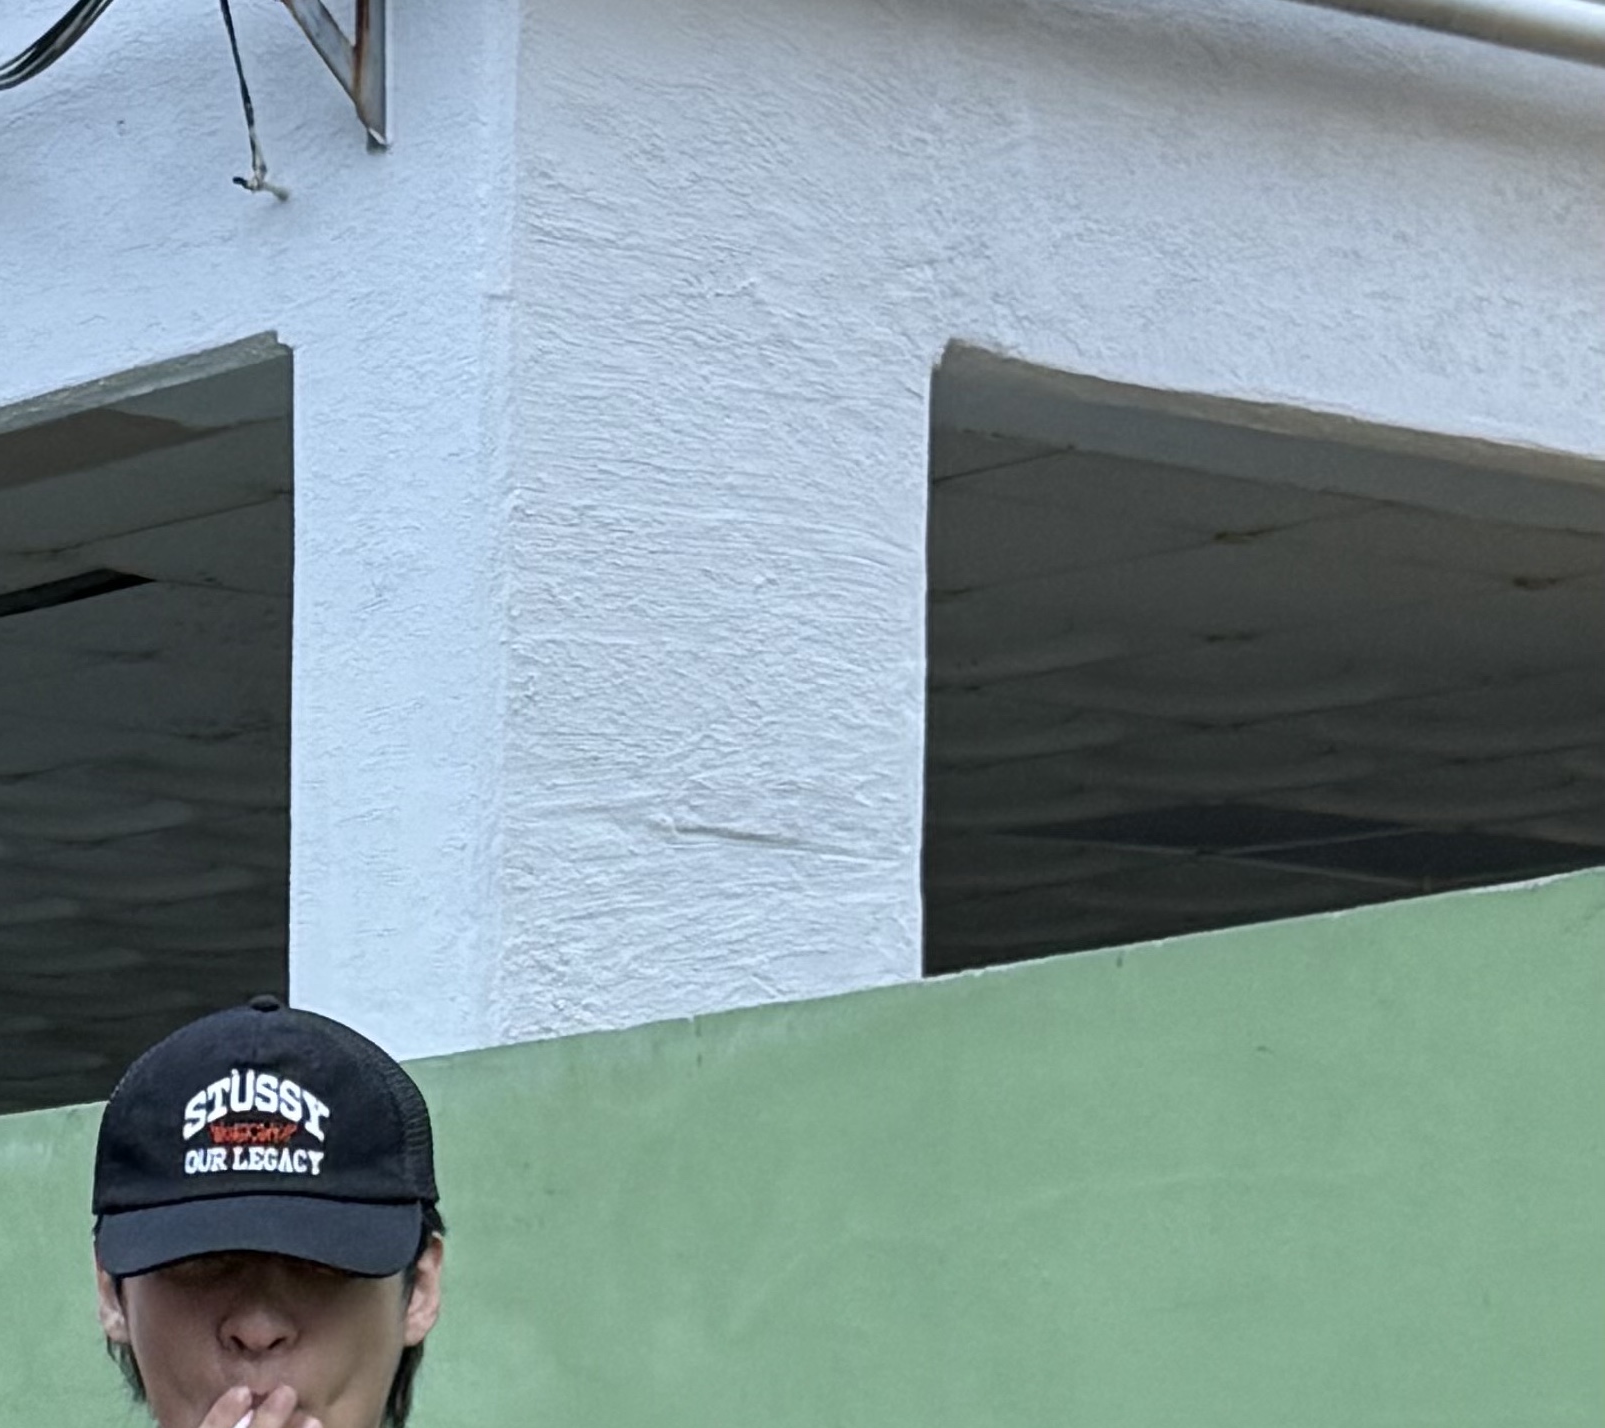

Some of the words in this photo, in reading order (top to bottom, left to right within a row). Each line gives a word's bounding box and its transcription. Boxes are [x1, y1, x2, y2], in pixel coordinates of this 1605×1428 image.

[182, 1068, 331, 1142] STUSSY
[184, 1147, 228, 1175] OUR
[231, 1146, 326, 1176] LEGACY
